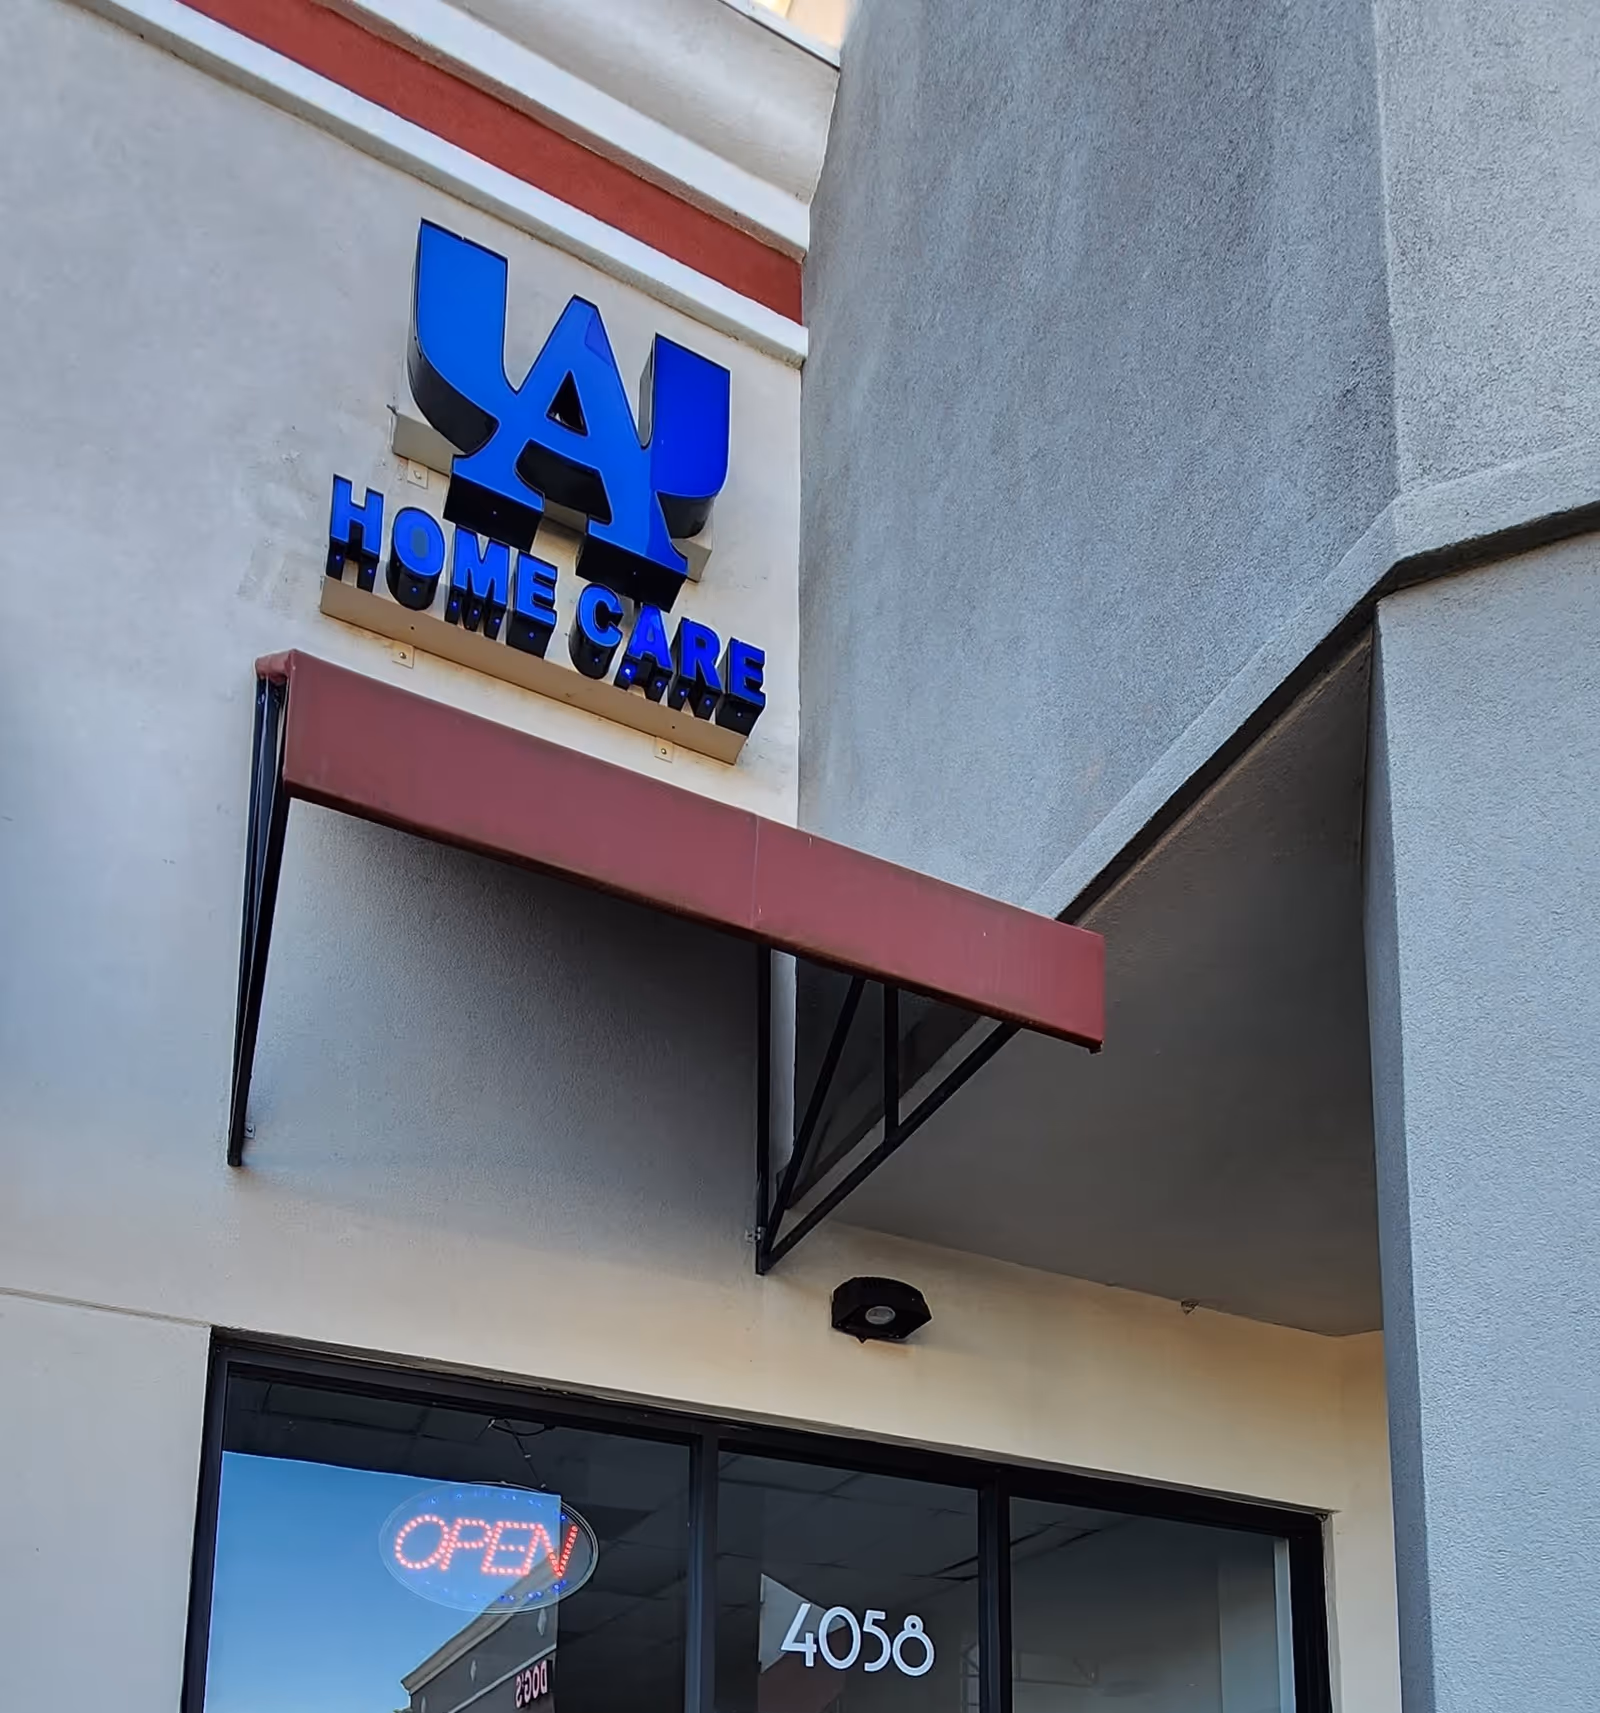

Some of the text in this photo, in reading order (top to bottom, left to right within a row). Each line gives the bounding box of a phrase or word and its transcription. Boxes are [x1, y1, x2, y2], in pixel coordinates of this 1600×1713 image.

[328, 474, 766, 714] HOME CARE
[394, 1513, 579, 1578] OPEN
[780, 1602, 935, 1677] 4058
